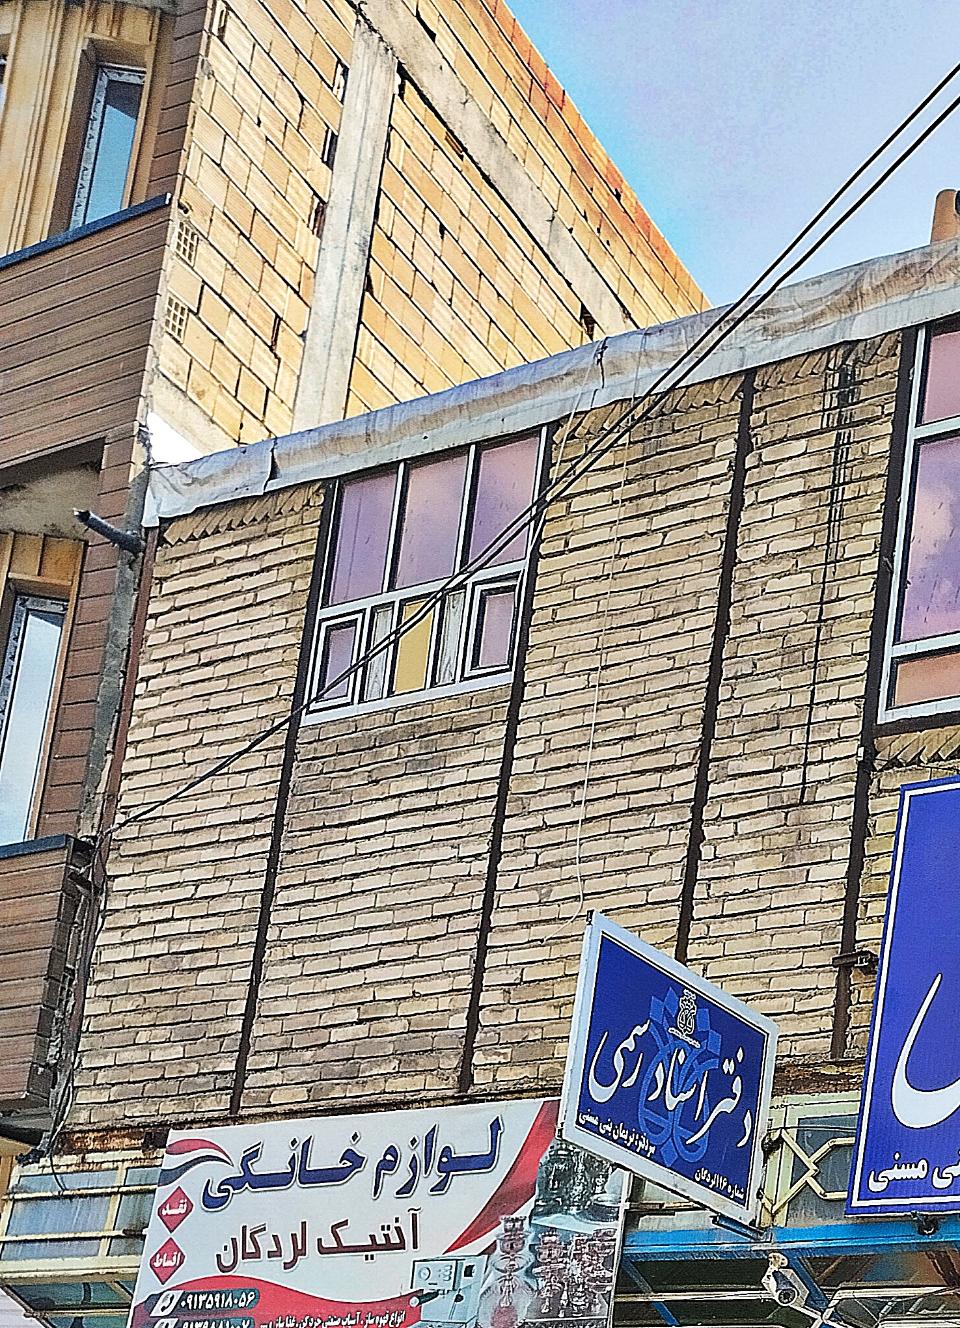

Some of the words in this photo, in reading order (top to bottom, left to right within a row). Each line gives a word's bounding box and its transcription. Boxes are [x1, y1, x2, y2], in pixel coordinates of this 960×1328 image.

[588, 1019, 650, 1103] رسمی
[648, 1048, 708, 1121] اسناد
[686, 1047, 751, 1148] دفتر
[202, 1131, 367, 1212] خانگی
[372, 1115, 503, 1199] لوازم
[868, 1153, 929, 1192] مسنی
[162, 1199, 188, 1216] نقد
[316, 1207, 421, 1261] آنتیک
[153, 1251, 182, 1268] اقساط
[216, 1220, 307, 1273] لردگان
[181, 1291, 256, 1311] ۰۹۱۳۵۹۱۸۰۵۶
[388, 1310, 406, 1328] انواع
